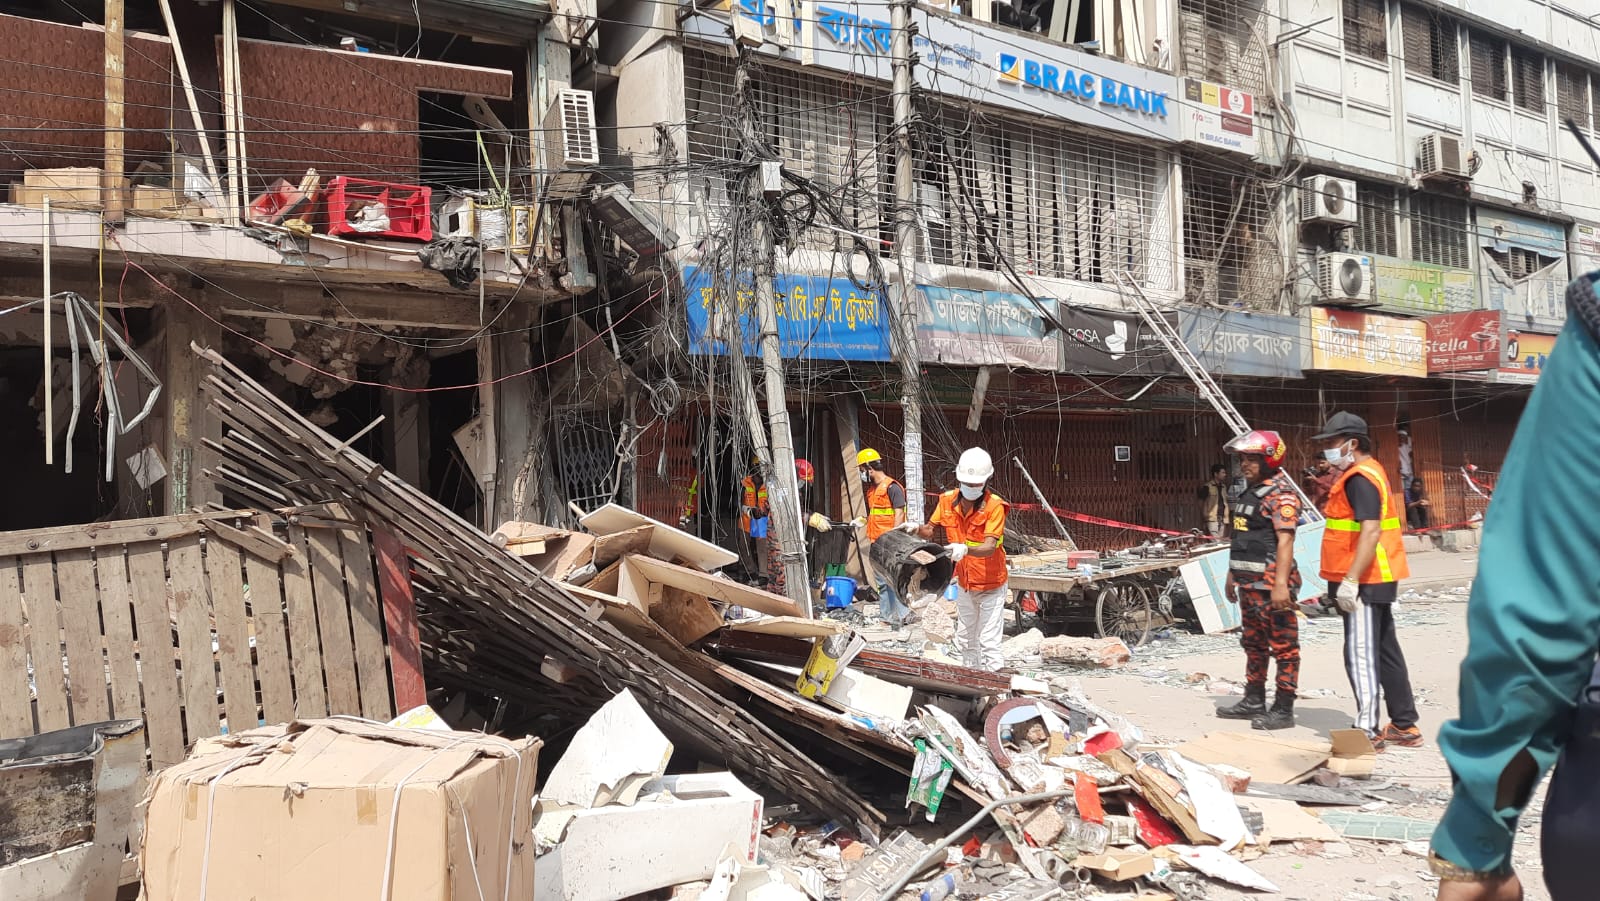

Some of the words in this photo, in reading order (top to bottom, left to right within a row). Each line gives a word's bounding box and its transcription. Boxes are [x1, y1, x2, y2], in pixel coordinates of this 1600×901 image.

[1023, 58, 1096, 99] BRAC
[1101, 77, 1168, 117] BANK
[935, 293, 982, 327] আজিজ
[1068, 328, 1101, 343] ROSA
[1252, 334, 1293, 359] ব্যাংক
[1425, 338, 1469, 353] Stella
